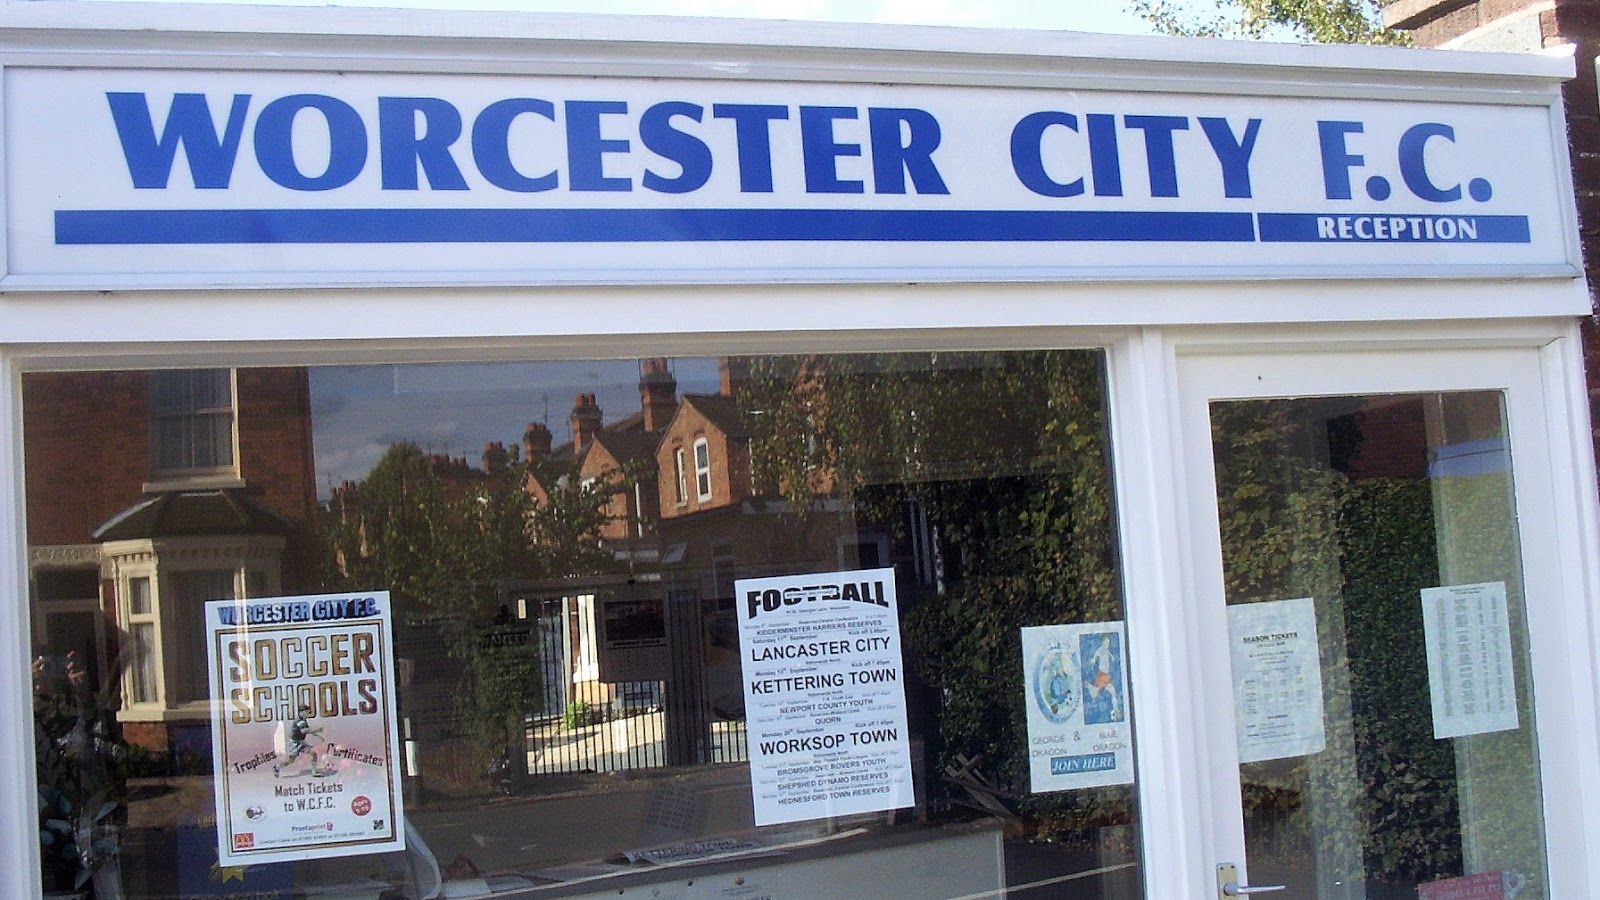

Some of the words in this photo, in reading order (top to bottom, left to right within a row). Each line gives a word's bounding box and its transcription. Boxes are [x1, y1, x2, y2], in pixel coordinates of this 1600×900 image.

[105, 92, 950, 195] WORCESTER
[1010, 110, 1262, 199] CITY
[1318, 120, 1493, 203] F.C.
[1317, 216, 1478, 241] RECEPTION
[312, 600, 348, 620] CITY
[747, 581, 889, 619] FOOTBALL
[756, 625, 810, 635] KIDDERMINSTER
[812, 622, 845, 630] HARRIERS
[848, 619, 882, 627] RESERVES
[229, 632, 376, 682] SOCCER
[752, 640, 850, 661] LANCASTER
[855, 636, 890, 651] CITY
[751, 673, 843, 694] KETTERING
[848, 668, 896, 684] TOWN
[231, 678, 378, 725] SCHOOLS
[779, 704, 815, 713] NEWPORT
[817, 701, 847, 709] COUNTY
[849, 698, 873, 706] YOUTH
[815, 716, 841, 724] QUORN
[760, 734, 844, 755] WORKSOP
[850, 728, 897, 745] TOWN
[1073, 731, 1080, 741] &
[234, 751, 277, 774] Trophies
[777, 764, 828, 776] BROMSGROVE
[830, 760, 859, 770] ROVERS
[862, 757, 886, 766] YOUTH
[1053, 760, 1078, 771] JOIN
[1082, 757, 1114, 769] HERE
[275, 784, 304, 797] Match
[307, 782, 343, 795] Tickets
[777, 780, 816, 790] SHEPSHED
[818, 776, 849, 785] DYNAMO
[850, 771, 888, 781] RESERVES
[284, 802, 294, 812] to
[297, 797, 336, 811] W.C.F.C.
[778, 793, 827, 805] HEDNESFORD
[830, 790, 850, 799] TOWN
[852, 785, 890, 796] RESERVES
